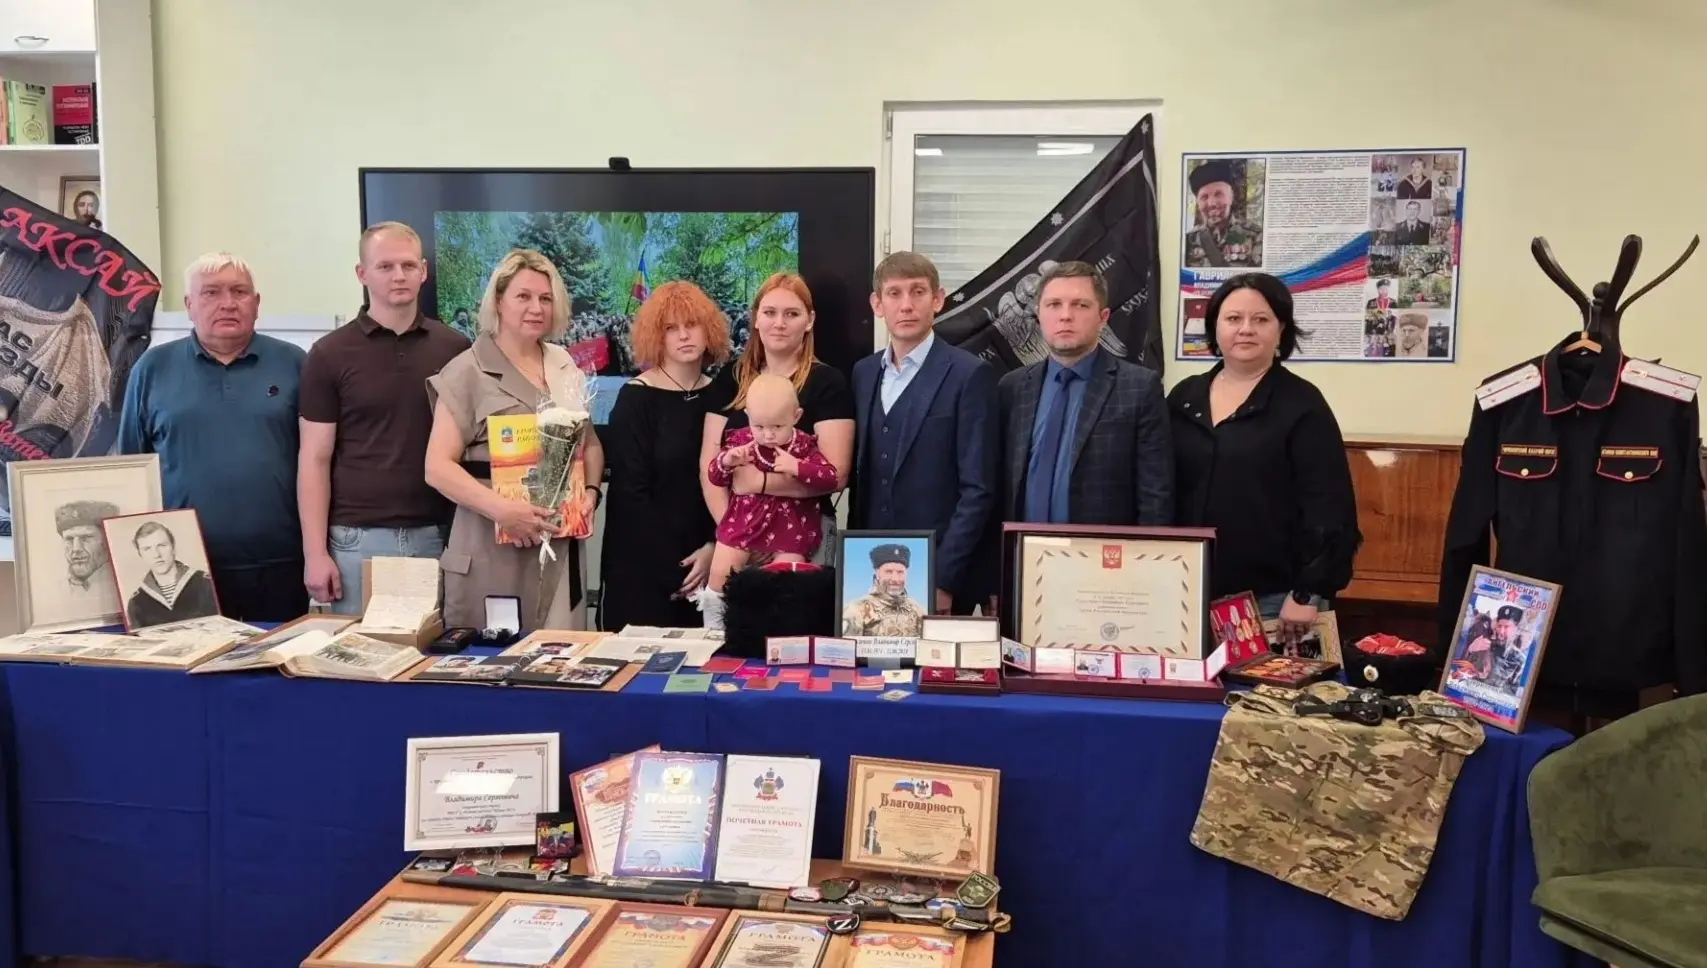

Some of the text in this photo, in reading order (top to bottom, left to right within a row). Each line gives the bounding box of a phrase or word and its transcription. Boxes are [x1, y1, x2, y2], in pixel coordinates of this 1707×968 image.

[0, 207, 161, 312] АКСАЙ
[879, 793, 966, 815] Благодарность
[768, 819, 803, 828] ГРАМОТА
[624, 931, 685, 941] ГРАМОТА
[749, 932, 816, 942] ГРАМОТА
[865, 949, 936, 961] ГРАМОТА
